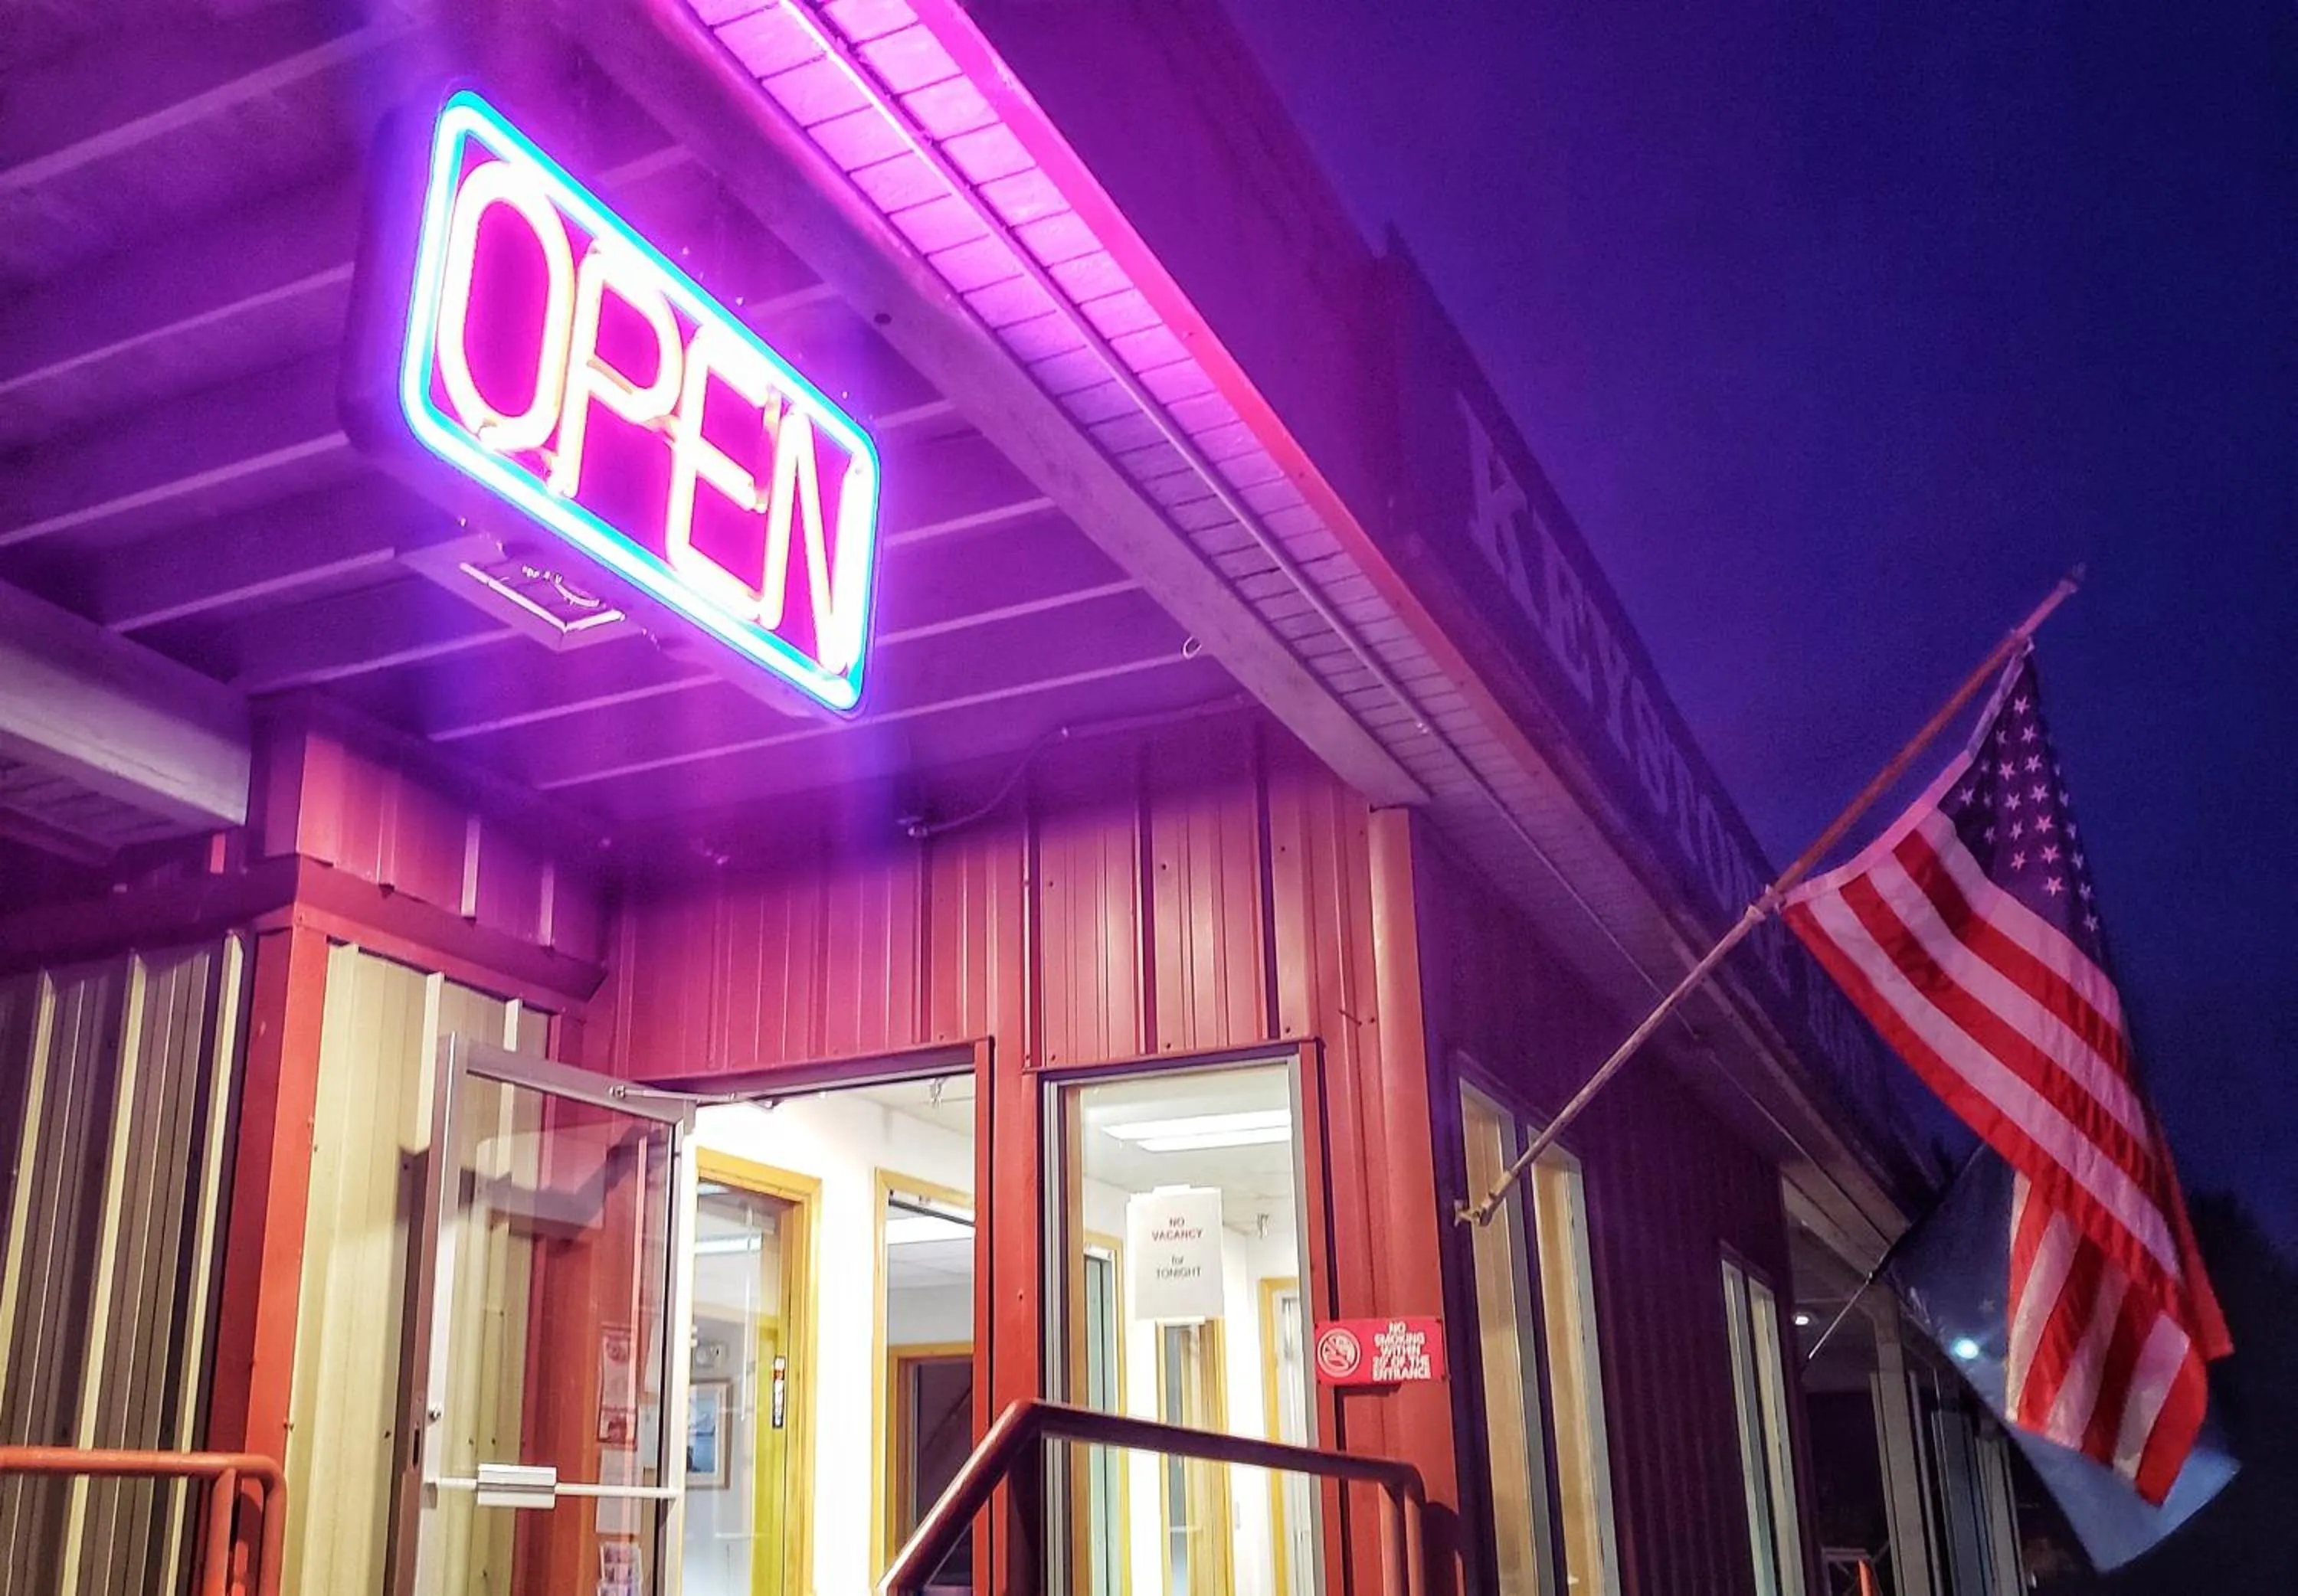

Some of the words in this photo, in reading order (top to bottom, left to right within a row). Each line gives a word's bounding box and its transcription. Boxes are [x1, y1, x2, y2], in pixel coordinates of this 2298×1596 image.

[436, 159, 873, 674] OPEN
[1169, 1216, 1185, 1228] NO
[1151, 1228, 1203, 1241] VACANCY
[1171, 1254, 1184, 1265] for
[1157, 1266, 1200, 1279] TONIGHT
[1389, 1321, 1406, 1336] NO
[1374, 1332, 1426, 1347] SMOKING
